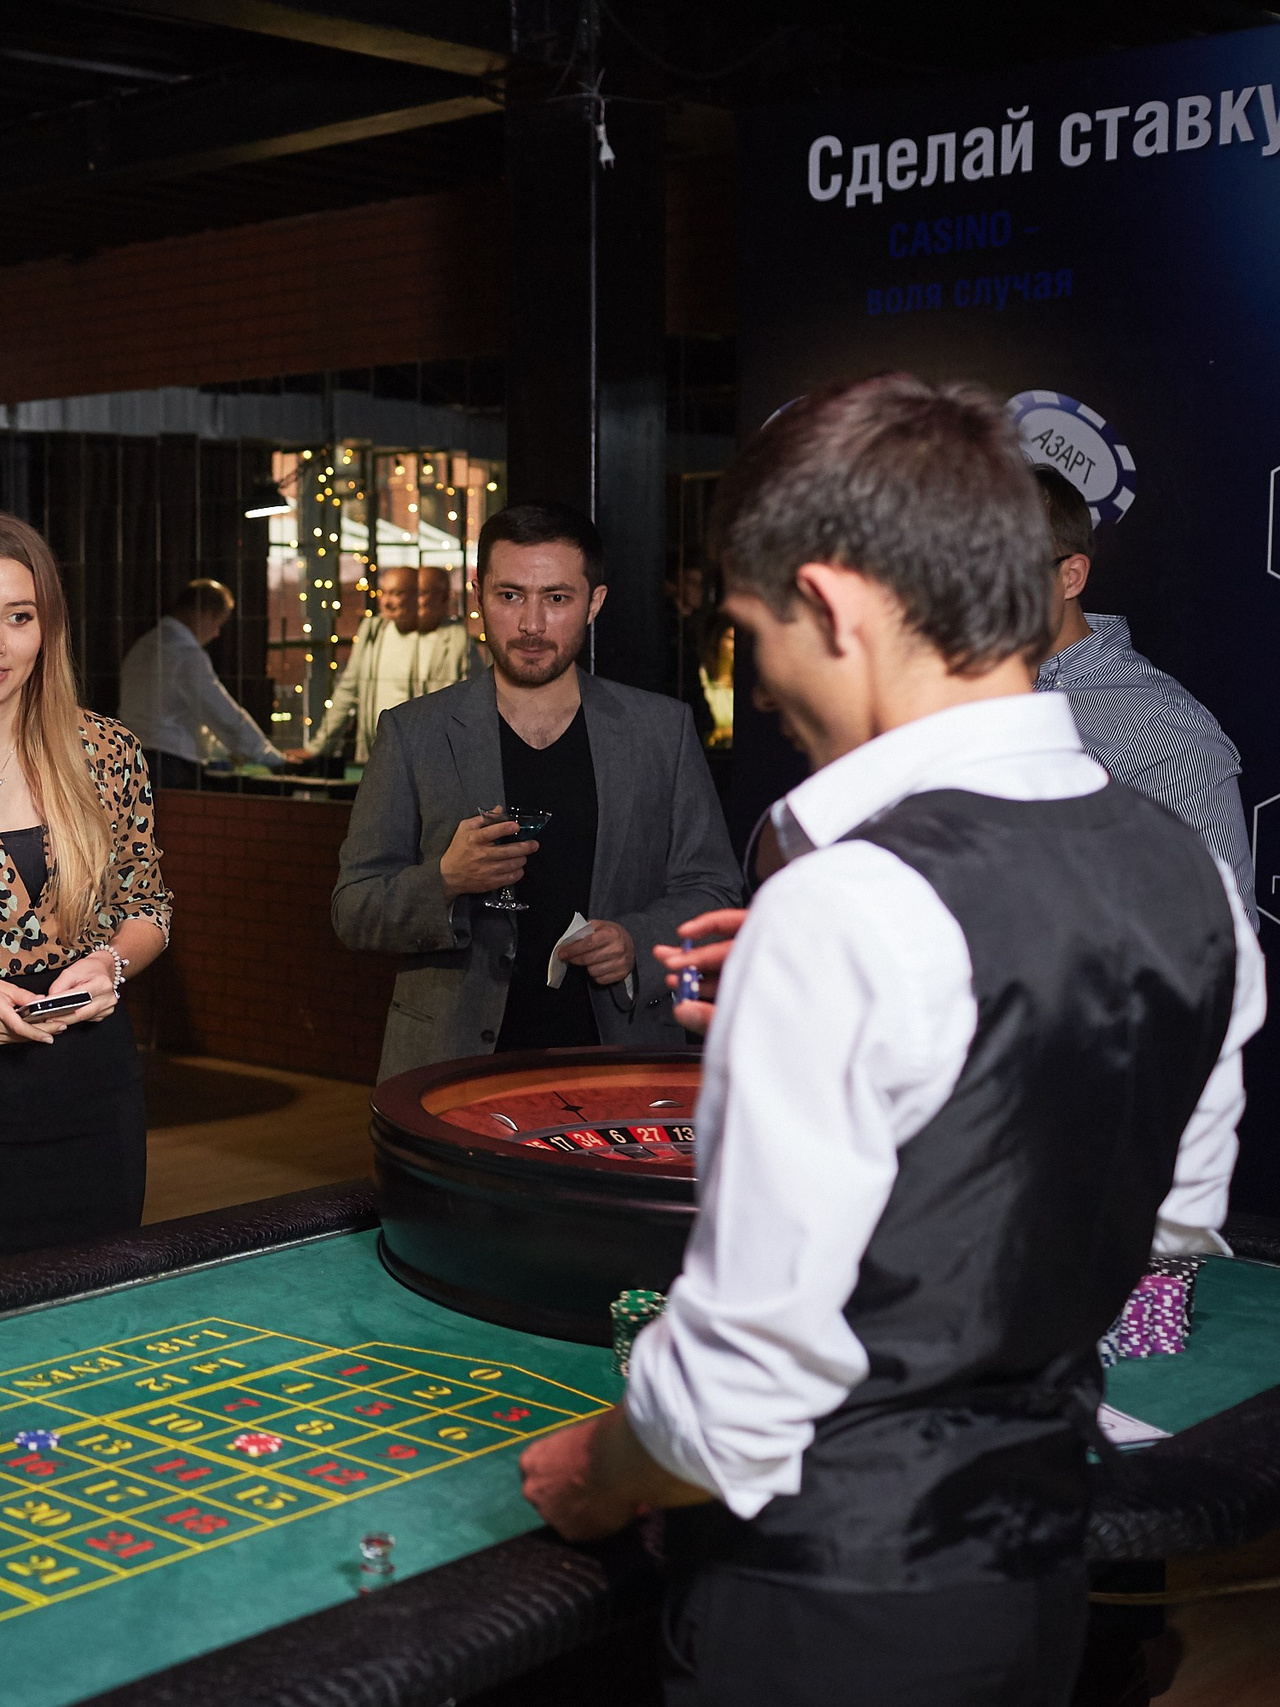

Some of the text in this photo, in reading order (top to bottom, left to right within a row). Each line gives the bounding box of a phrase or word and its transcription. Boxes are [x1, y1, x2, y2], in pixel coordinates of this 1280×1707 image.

[807, 104, 1035, 208] Сделай
[888, 210, 1012, 259] CASINO
[867, 268, 1074, 315] воля случая
[1031, 429, 1096, 484] АЗАРТ
[549, 1136, 575, 1151] 17
[573, 1132, 603, 1149] 34
[609, 1129, 627, 1144] 6
[636, 1127, 661, 1142] 27
[672, 1126, 696, 1141] 13
